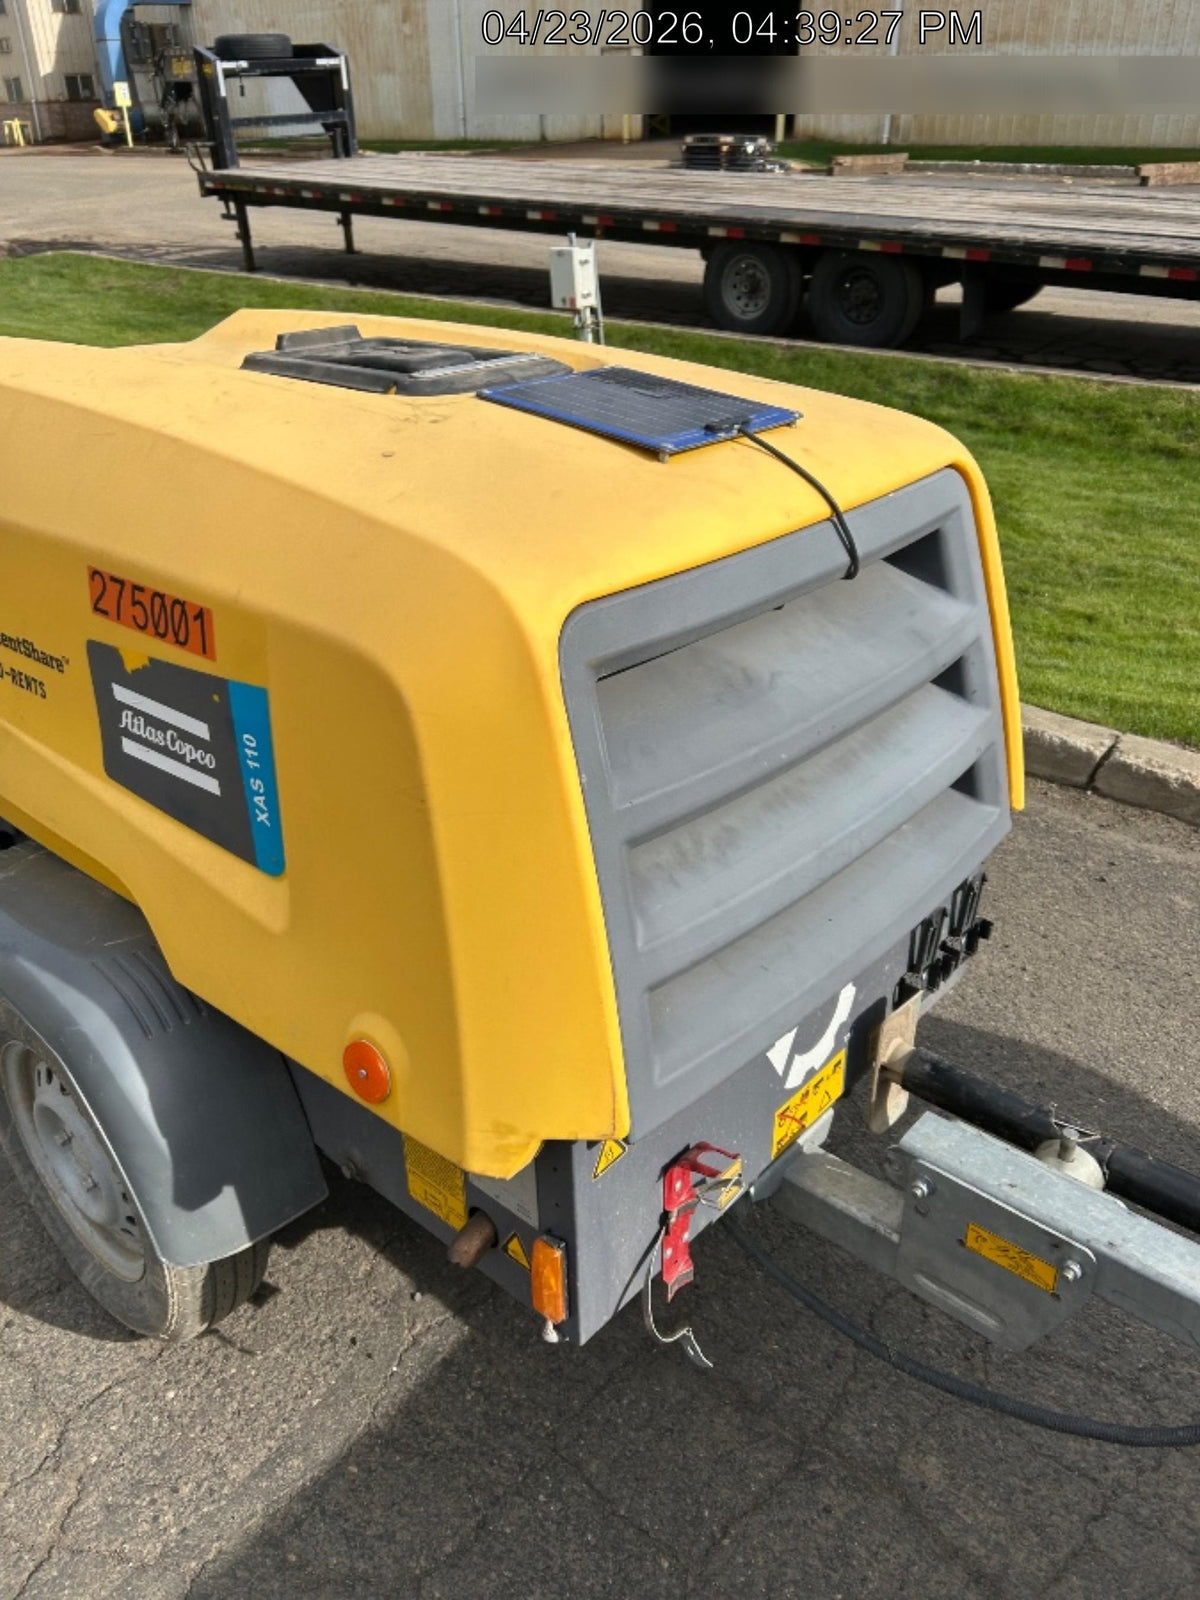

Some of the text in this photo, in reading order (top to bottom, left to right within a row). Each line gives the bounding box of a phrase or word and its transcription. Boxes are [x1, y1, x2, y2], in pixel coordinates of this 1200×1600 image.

[91, 569, 207, 655] 275001
[242, 733, 271, 827] XAS 110
